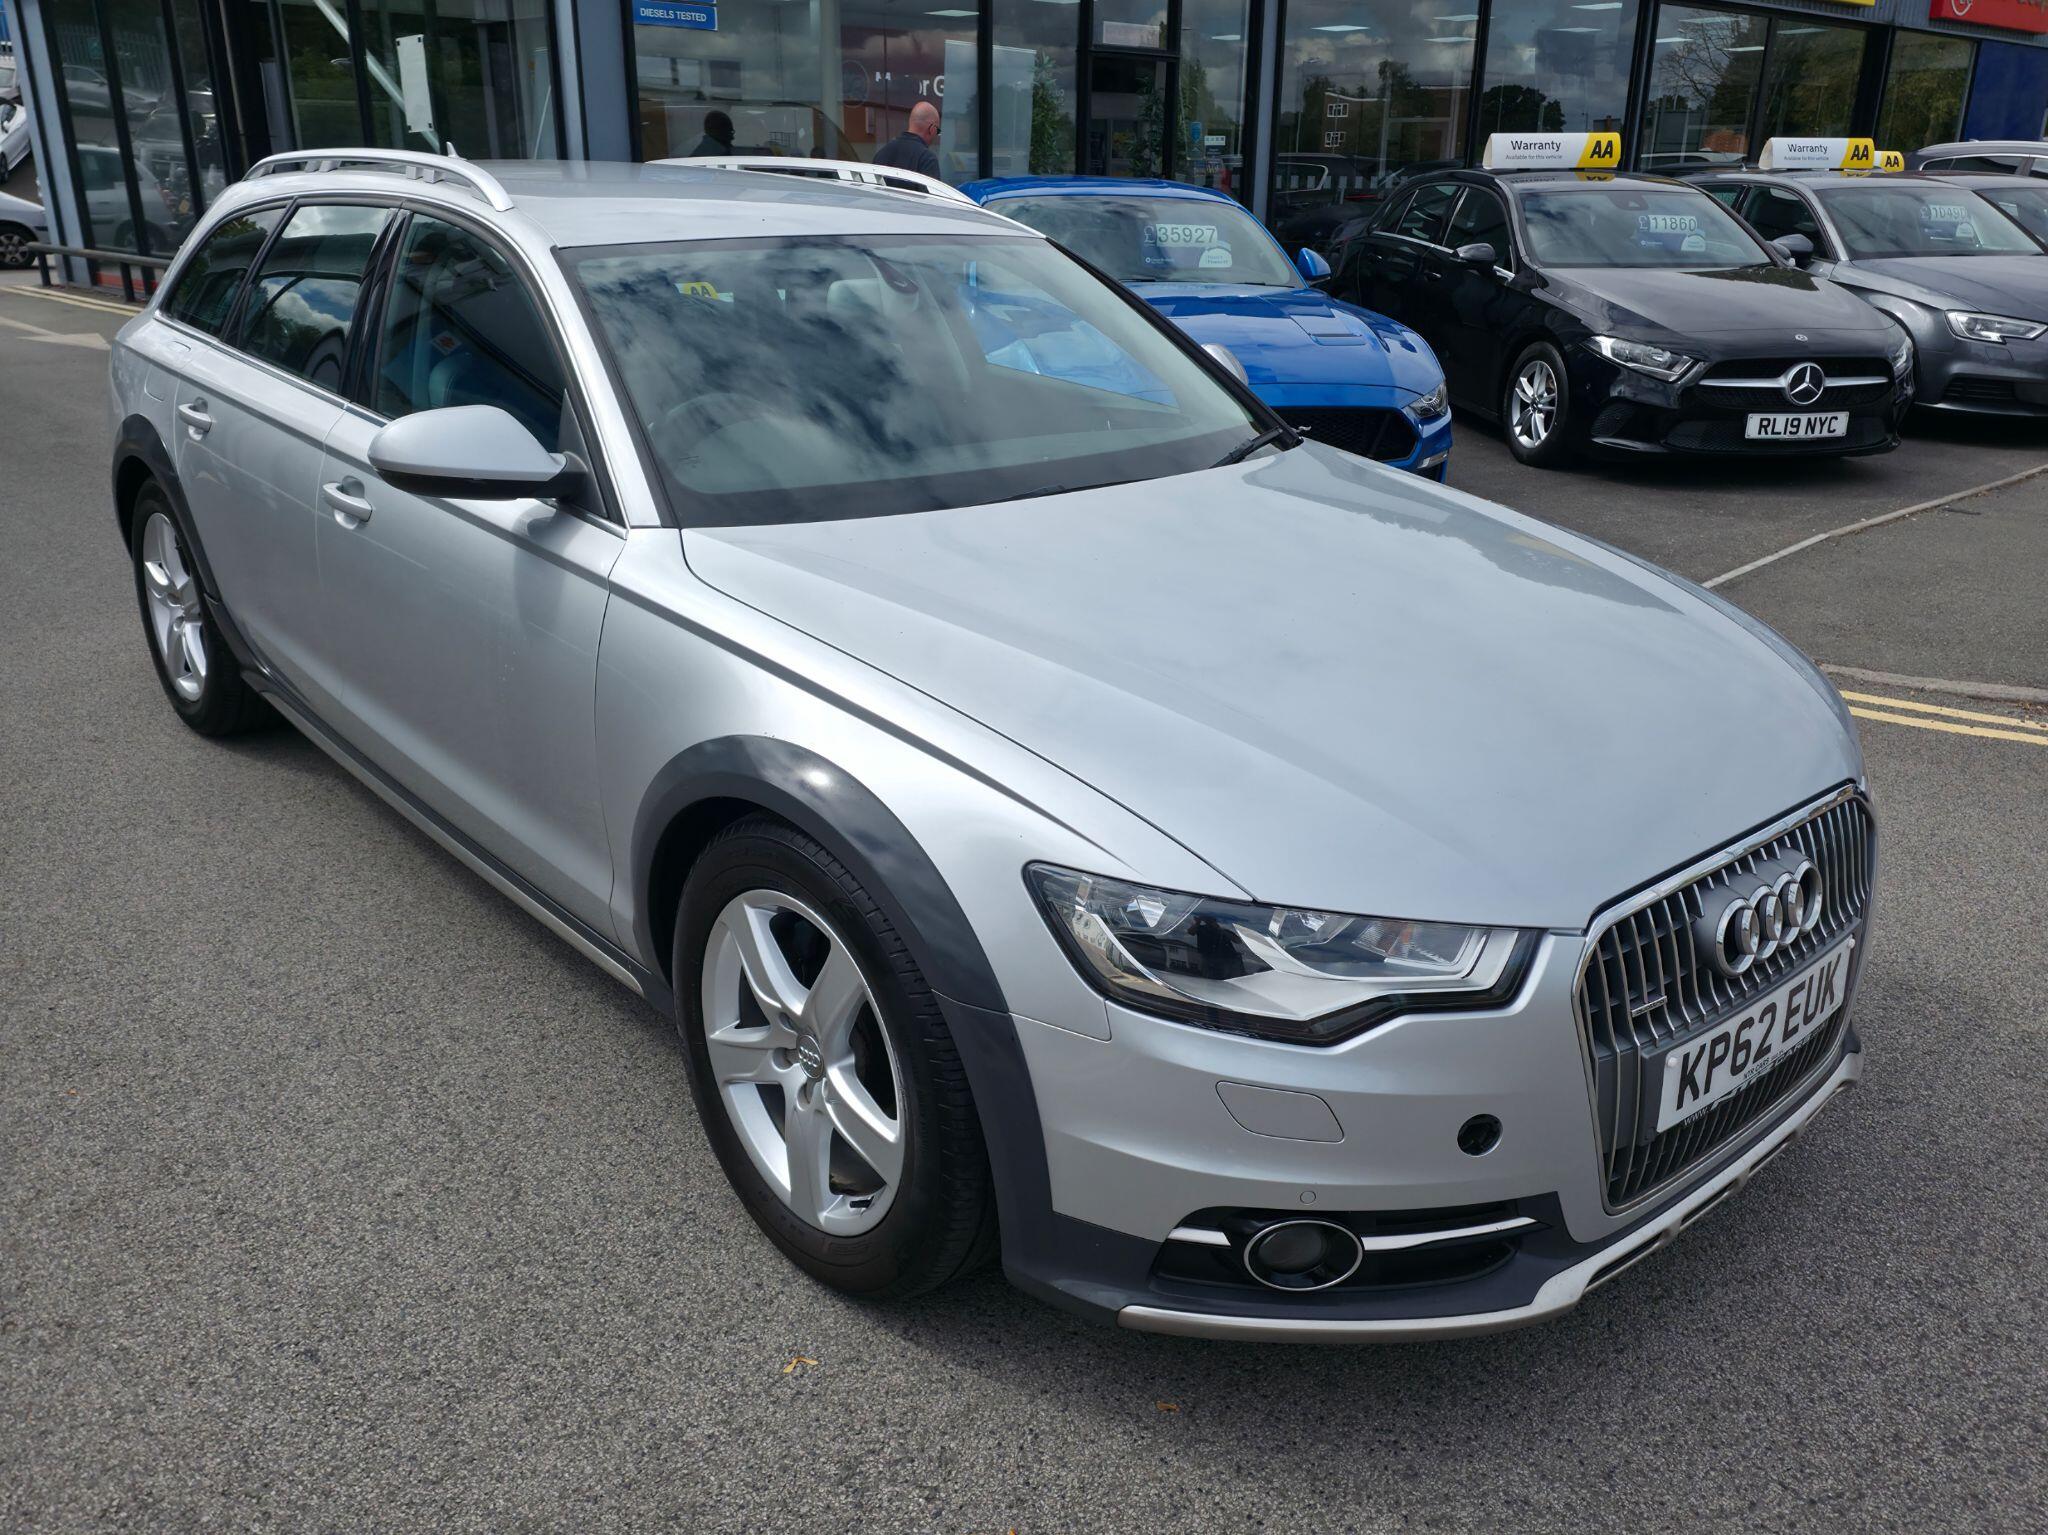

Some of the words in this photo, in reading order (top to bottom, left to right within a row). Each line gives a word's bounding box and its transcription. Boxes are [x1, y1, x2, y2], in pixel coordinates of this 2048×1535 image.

[640, 8, 674, 19] DIESELS
[676, 11, 707, 22] TESTED
[1511, 140, 1561, 152] Warranty
[1590, 140, 1613, 159] AA
[1787, 144, 1828, 155] Warranty
[1850, 145, 1869, 161] AA
[1885, 156, 1900, 168] AA
[1758, 417, 1801, 435] RL19
[1805, 416, 1838, 434] NYC
[1676, 1002, 1777, 1111] KP62
[1782, 953, 1842, 1044] EUK
